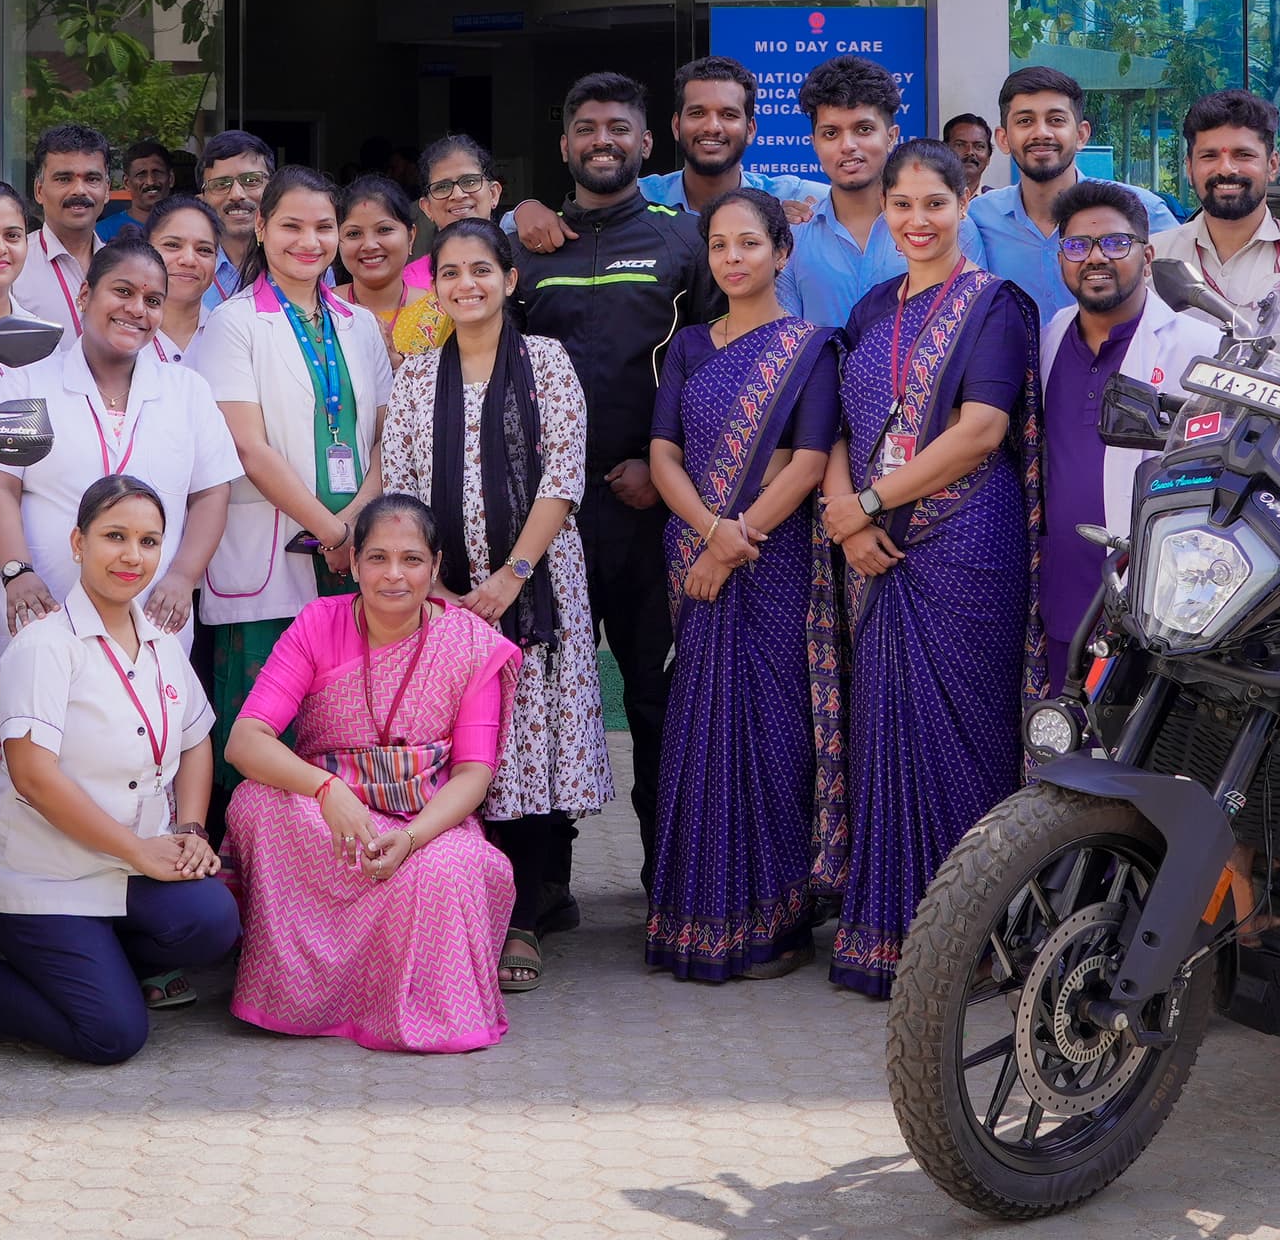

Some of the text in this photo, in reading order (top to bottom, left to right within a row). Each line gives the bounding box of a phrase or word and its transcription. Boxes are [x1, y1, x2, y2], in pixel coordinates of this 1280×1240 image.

[755, 41, 883, 52] MIO DAY CARE
[605, 259, 657, 270] AXOR
[1210, 370, 1237, 394] KA
